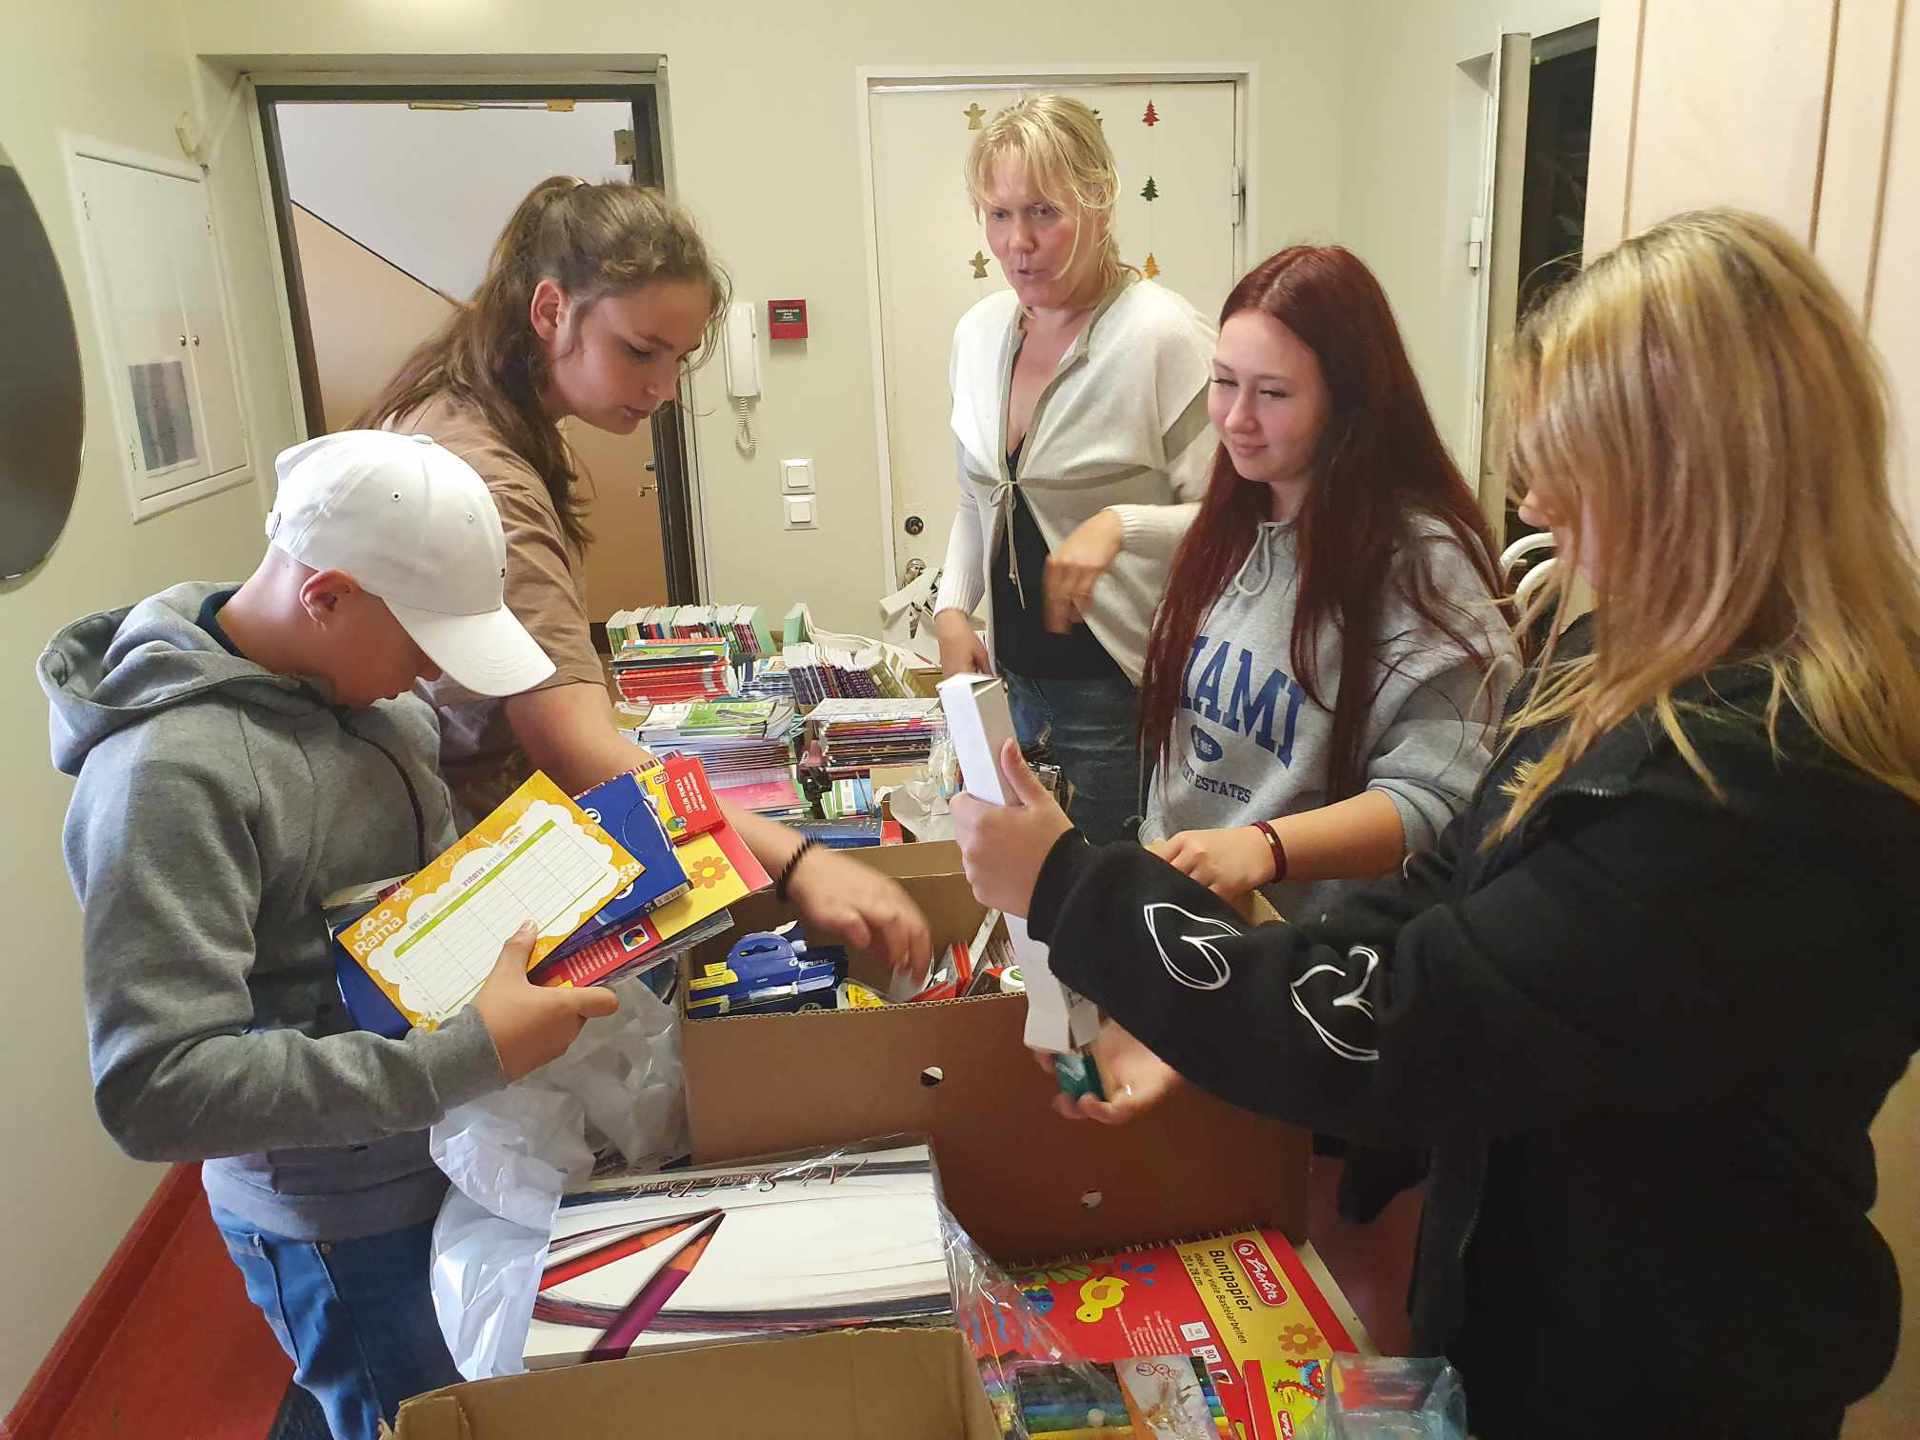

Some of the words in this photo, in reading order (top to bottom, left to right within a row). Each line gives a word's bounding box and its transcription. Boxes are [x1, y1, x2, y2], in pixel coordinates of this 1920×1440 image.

[1181, 635, 1306, 769] IAMI
[1195, 774, 1252, 803] ESTATES
[352, 917, 404, 956] Rama
[1208, 1248, 1253, 1312] Buntpapier
